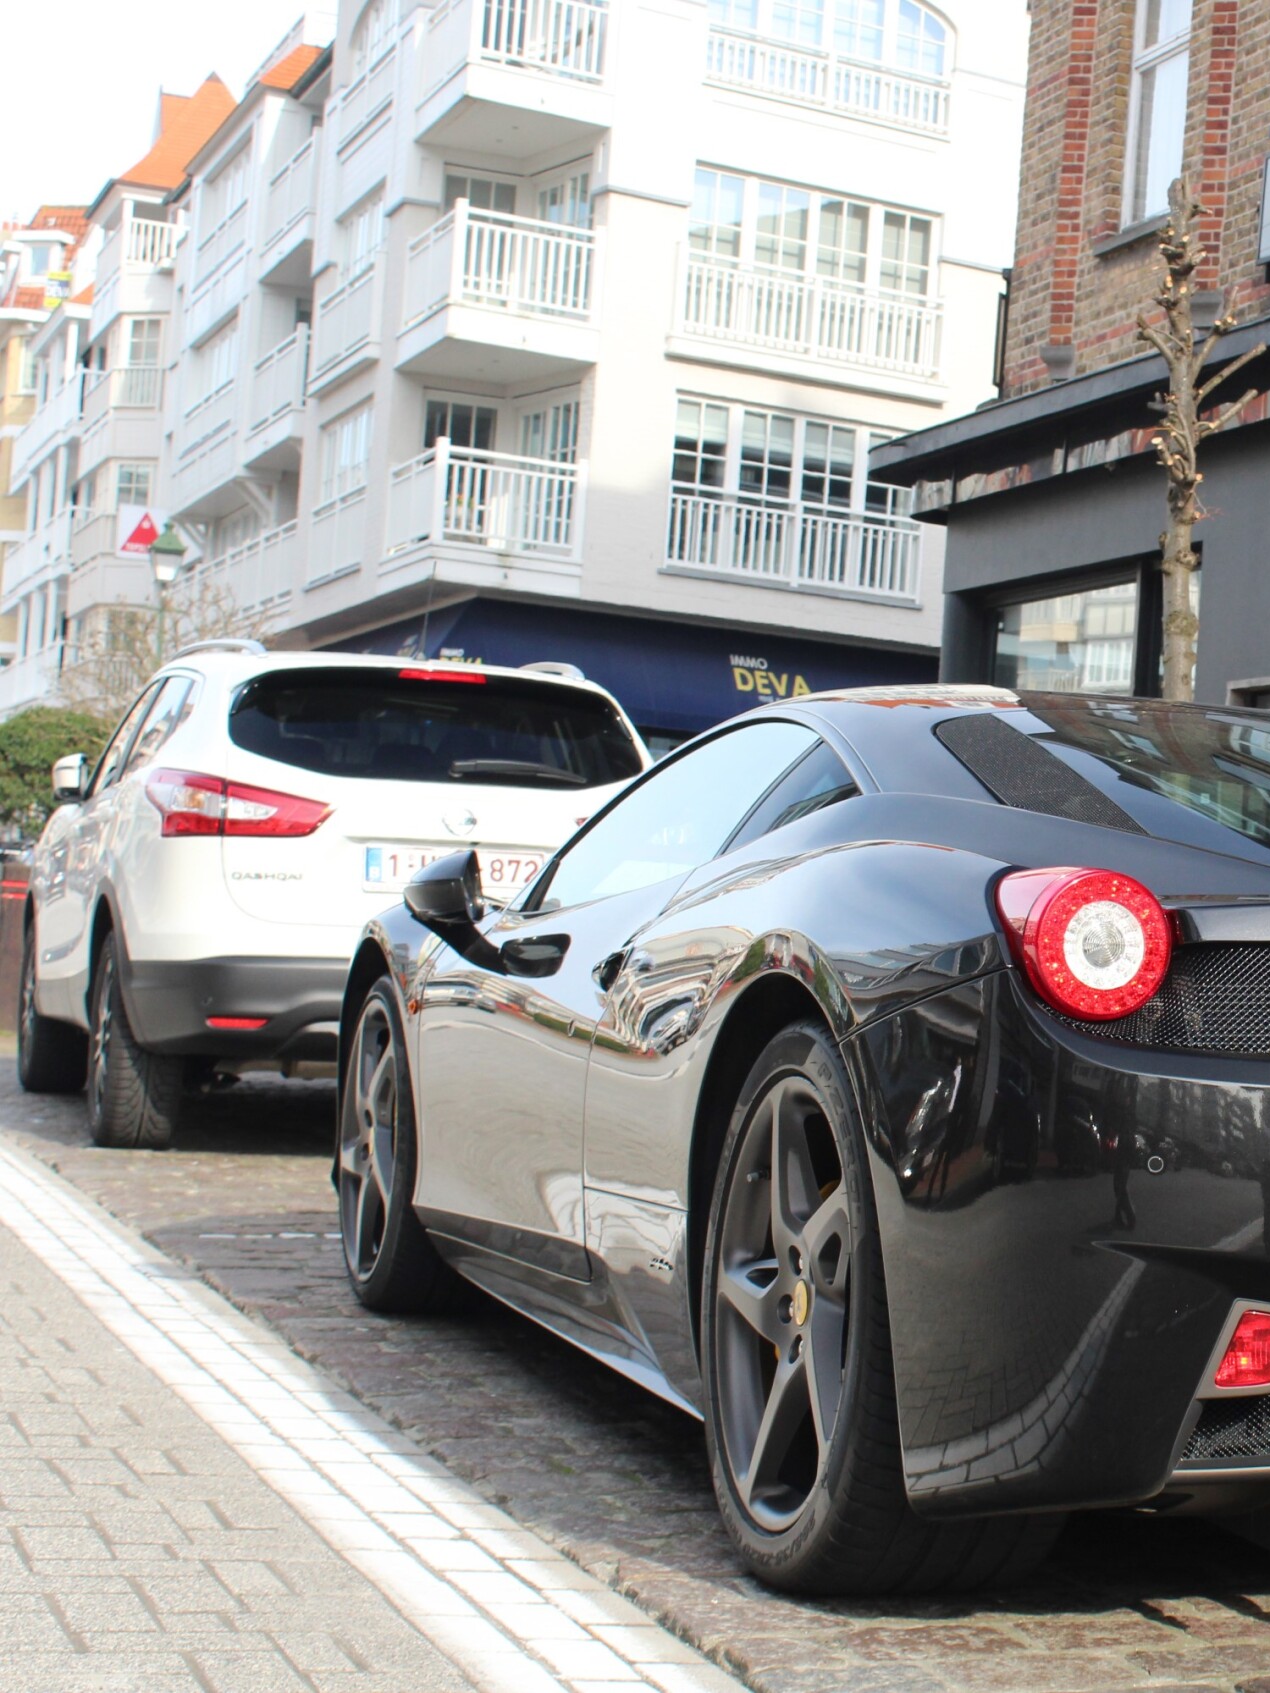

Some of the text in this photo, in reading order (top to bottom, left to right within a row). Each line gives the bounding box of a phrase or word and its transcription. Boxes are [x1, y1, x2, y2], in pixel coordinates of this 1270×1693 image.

[729, 653, 768, 670] IMMO
[732, 667, 812, 698] DEVA
[231, 871, 303, 882] QASHQAI
